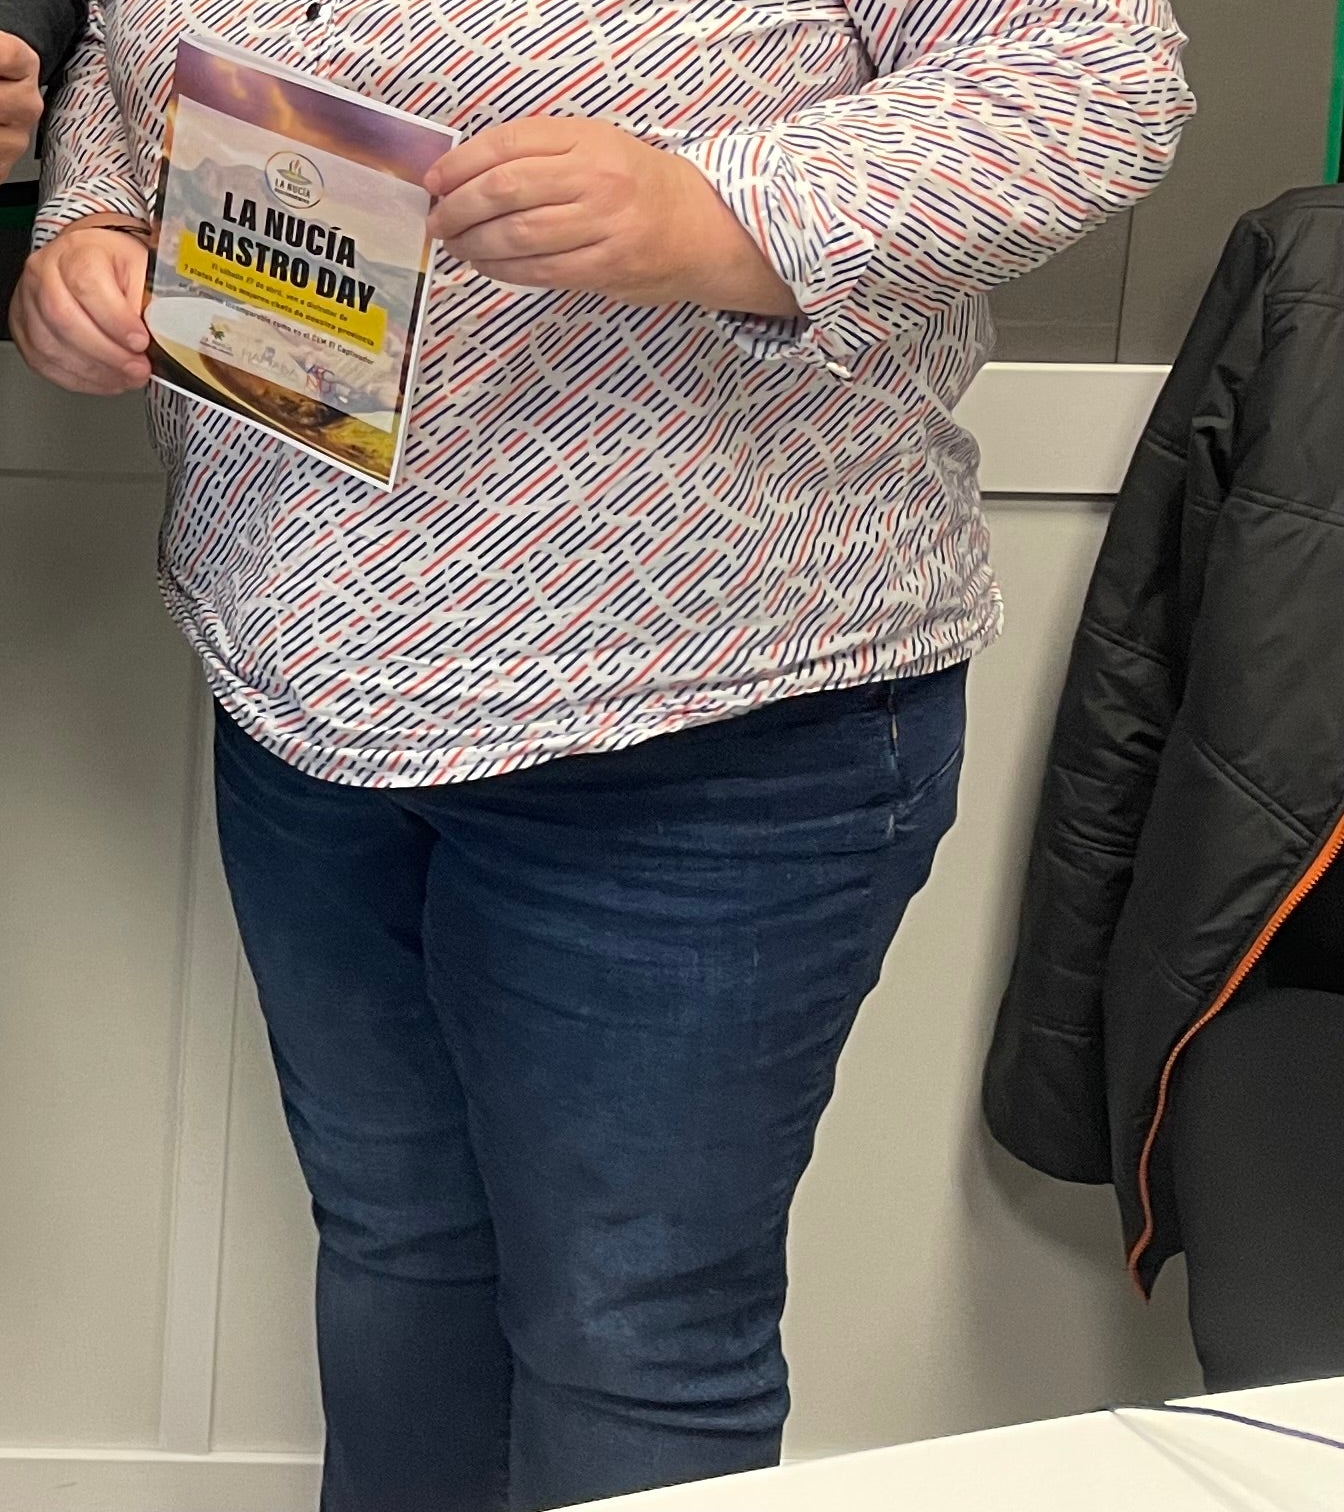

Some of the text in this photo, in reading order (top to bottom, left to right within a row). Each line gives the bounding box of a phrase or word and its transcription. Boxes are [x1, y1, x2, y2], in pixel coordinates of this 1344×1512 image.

[275, 177, 285, 189] LA
[197, 221, 310, 288] GASTRO
[316, 269, 376, 314] DAY
[223, 191, 356, 269] LA NUCÍA
